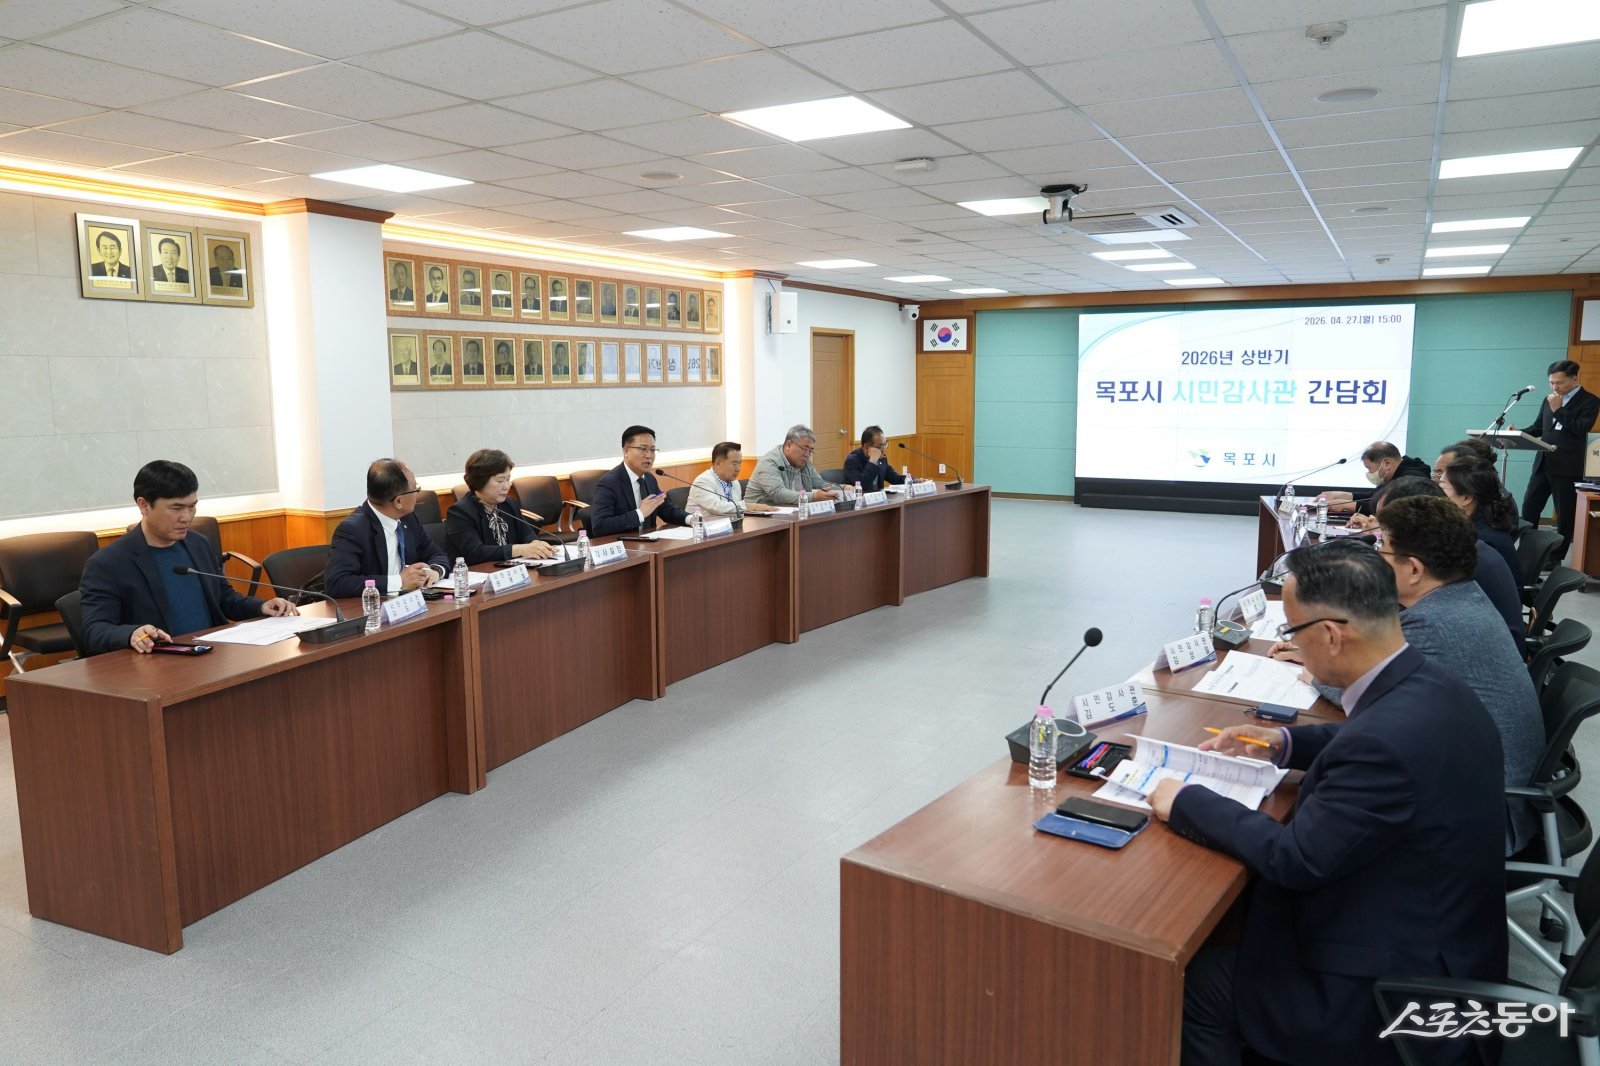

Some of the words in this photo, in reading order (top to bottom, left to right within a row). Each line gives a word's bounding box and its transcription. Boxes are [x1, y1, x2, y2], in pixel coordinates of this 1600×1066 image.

[1305, 317, 1327, 325] 2026.
[1378, 315, 1402, 323] 15:00
[1181, 350, 1233, 366] 2026년
[1240, 349, 1290, 366] 상반기
[1095, 380, 1162, 404] 목포시
[1172, 379, 1298, 404] 시민감사관
[1307, 379, 1388, 405] 간담회
[1223, 452, 1276, 468] 목포시
